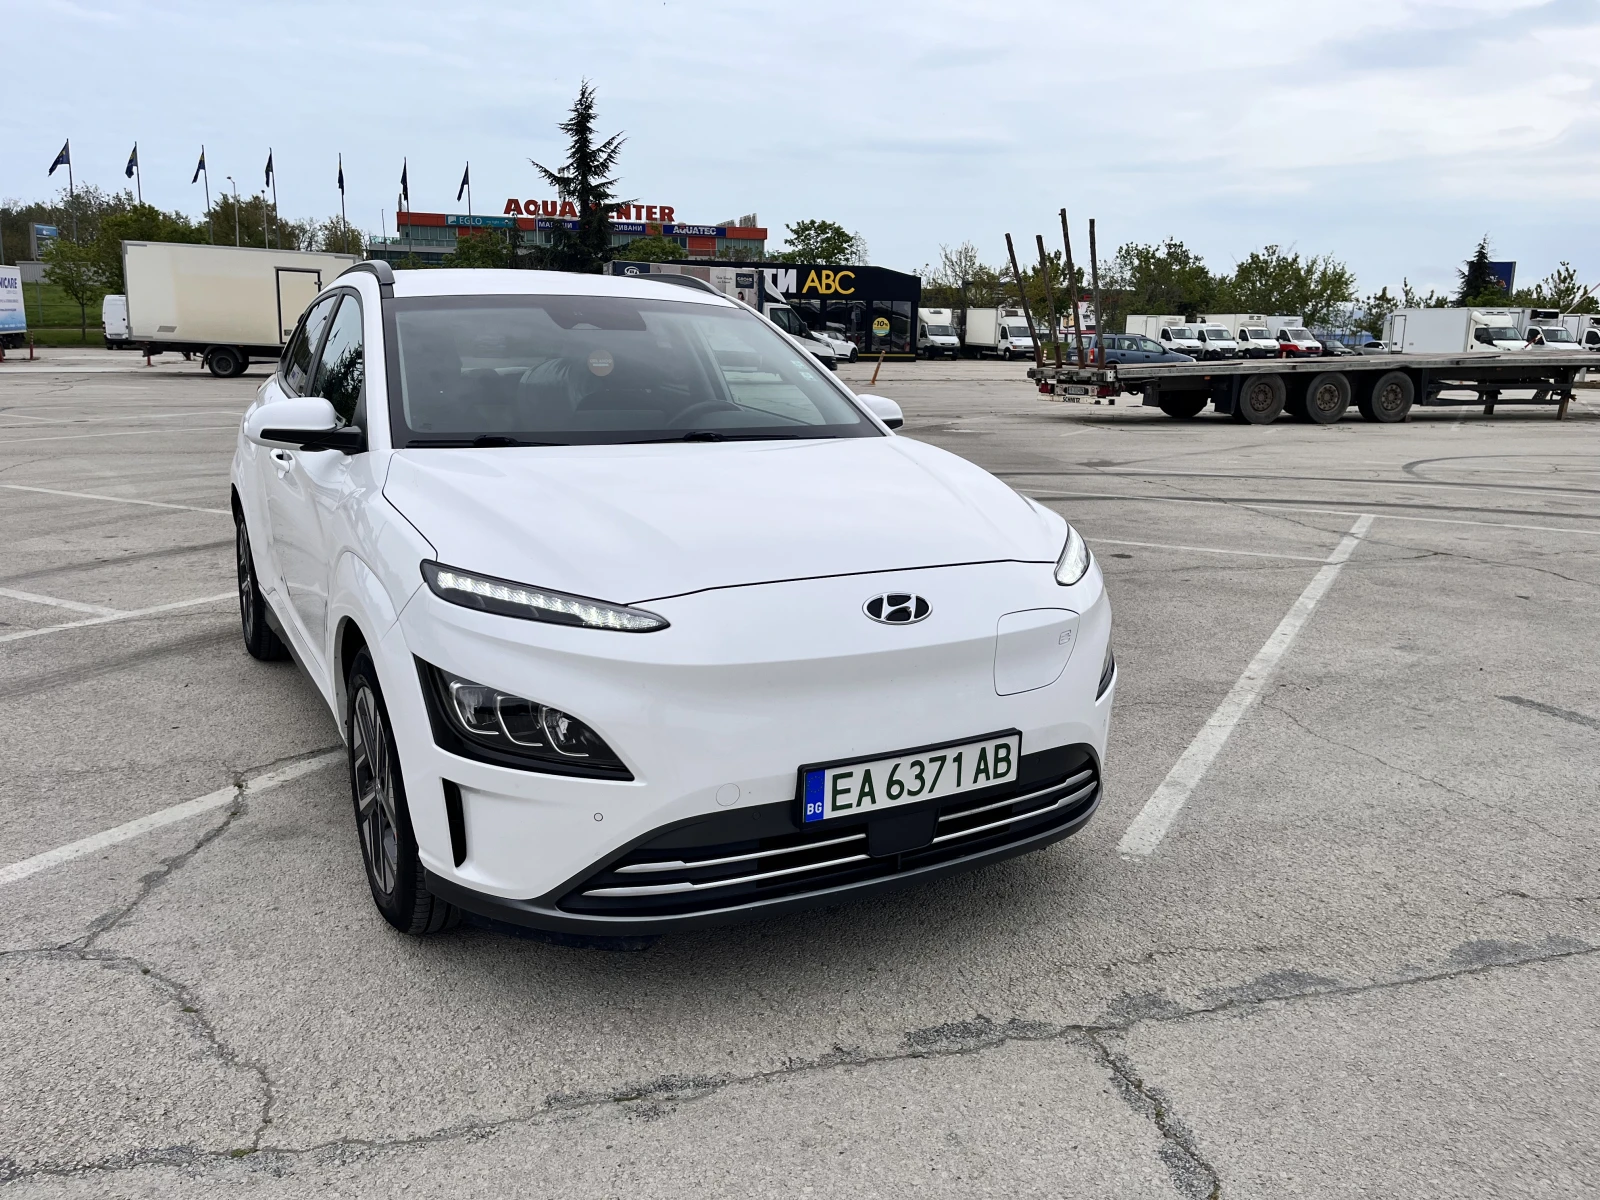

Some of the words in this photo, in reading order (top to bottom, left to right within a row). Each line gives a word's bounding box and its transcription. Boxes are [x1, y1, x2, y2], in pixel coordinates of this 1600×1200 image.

[503, 198, 578, 217] AQUA
[596, 203, 675, 222] NTER
[460, 216, 482, 225] EGLO
[614, 224, 643, 232] ДИВАНИ
[673, 224, 717, 235] AQUATEC
[801, 269, 856, 295] ABC
[831, 768, 877, 812] EA
[885, 751, 963, 801] 6371
[972, 742, 1012, 784] AB
[806, 801, 823, 816] BG
